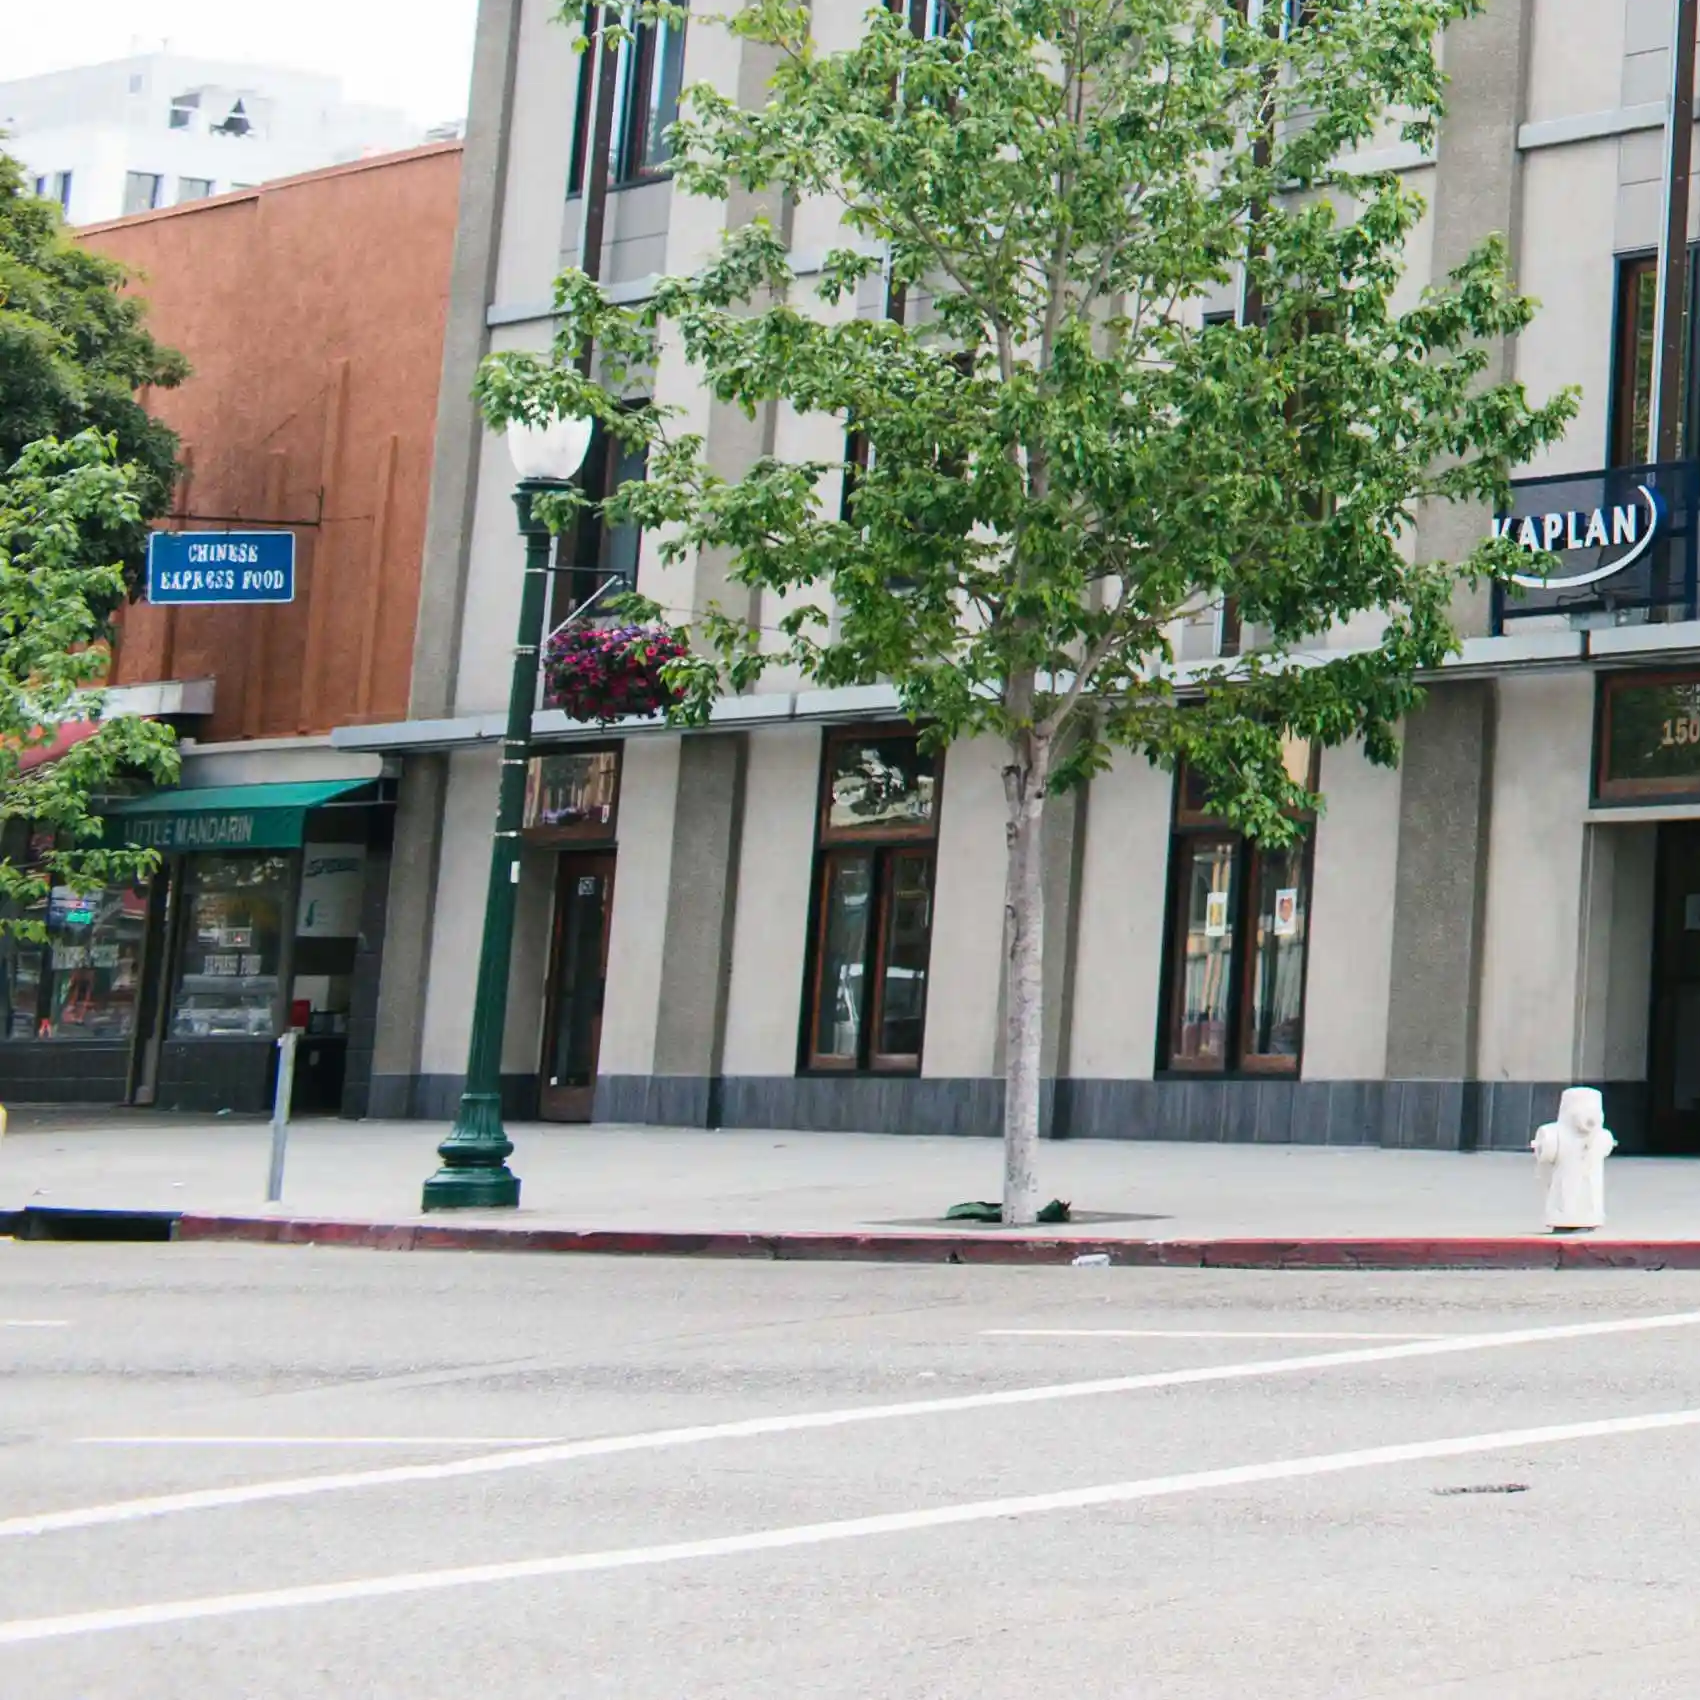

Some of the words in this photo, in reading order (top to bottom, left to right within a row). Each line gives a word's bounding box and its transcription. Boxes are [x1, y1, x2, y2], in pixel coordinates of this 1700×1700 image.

[188, 543, 258, 563] CHINESE
[160, 570, 235, 590] EXPRESS
[242, 570, 284, 590] FOOD
[124, 819, 171, 844] LITTLE
[175, 815, 254, 842] MANDARIN
